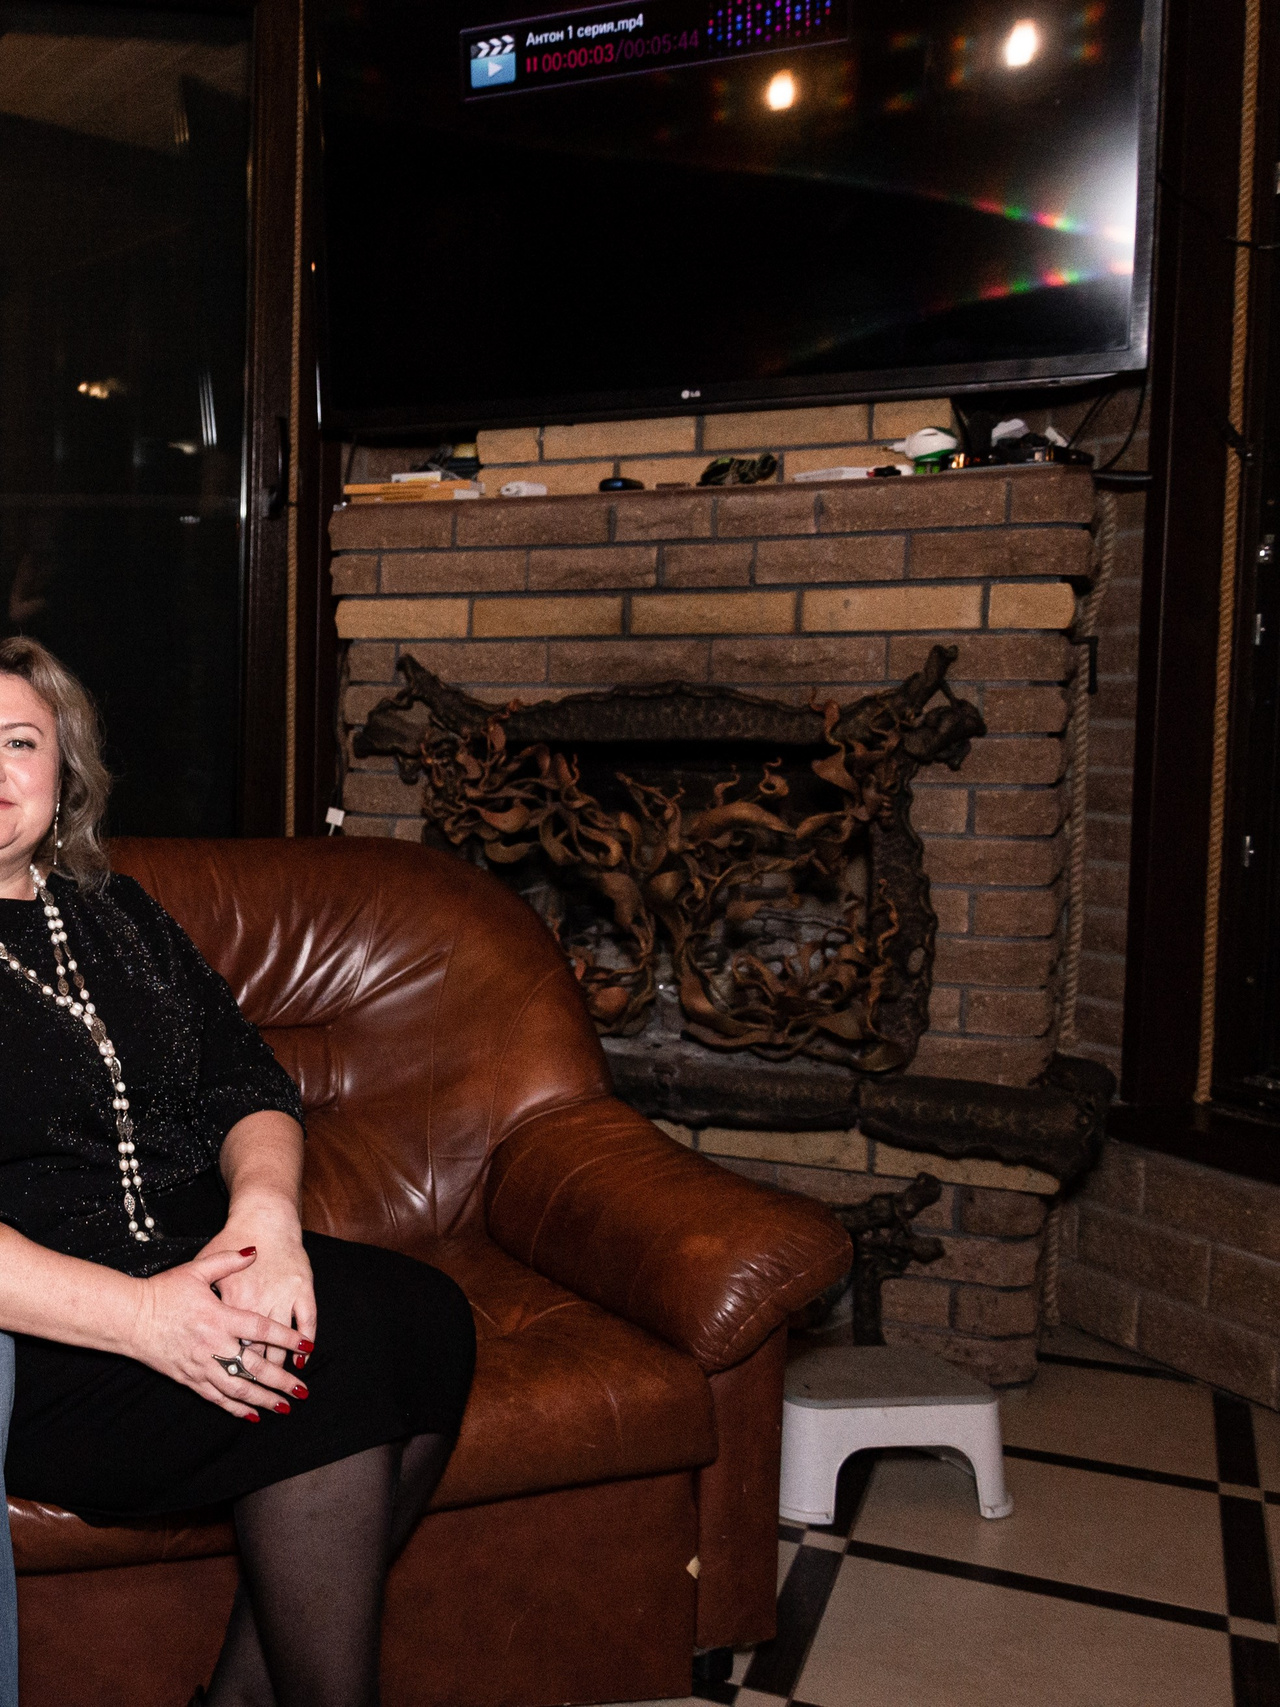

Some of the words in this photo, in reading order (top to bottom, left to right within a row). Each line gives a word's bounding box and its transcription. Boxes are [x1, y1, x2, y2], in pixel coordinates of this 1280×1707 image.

[525, 31, 564, 47] Антон
[567, 25, 574, 40] 1
[576, 13, 644, 39] серия.mp4
